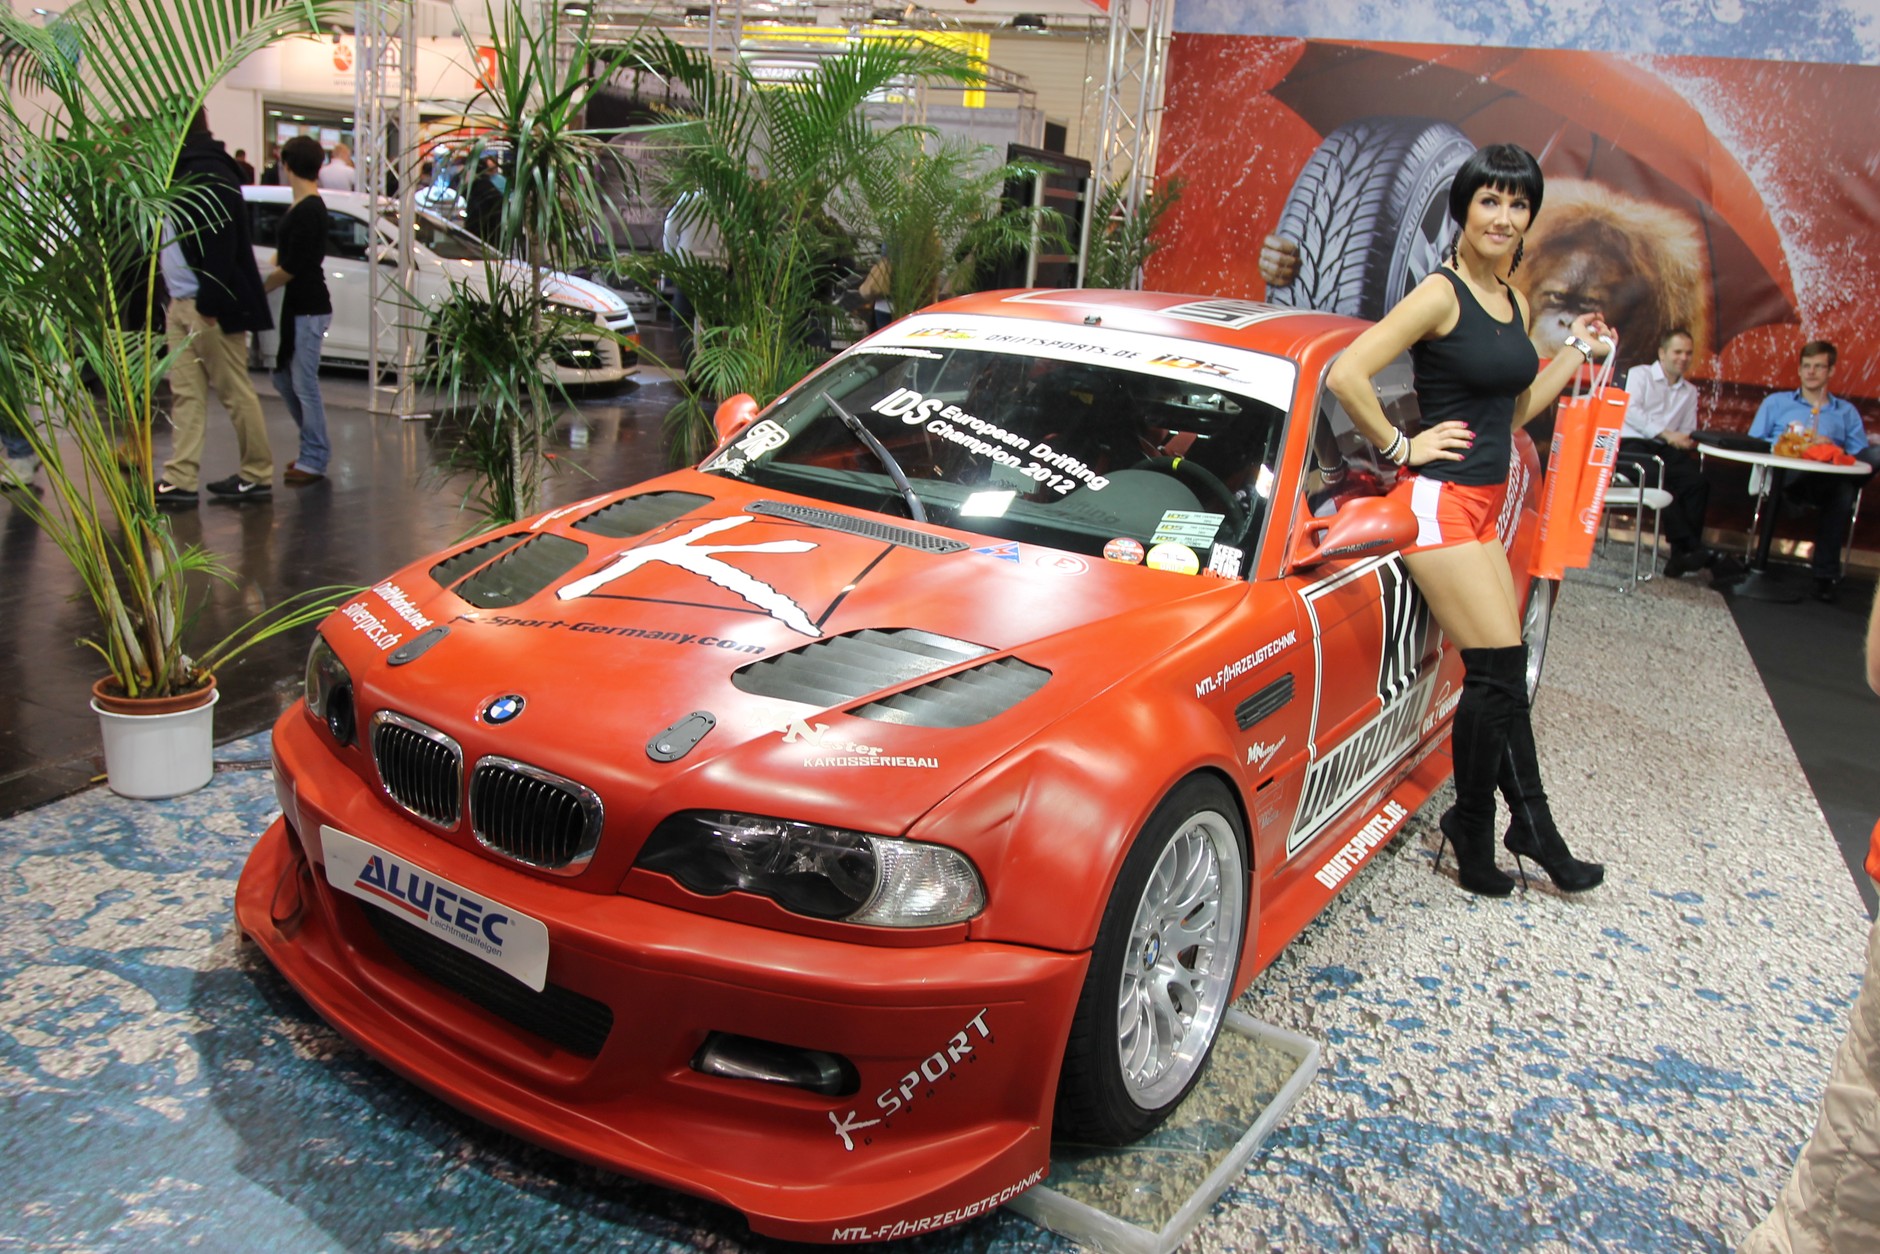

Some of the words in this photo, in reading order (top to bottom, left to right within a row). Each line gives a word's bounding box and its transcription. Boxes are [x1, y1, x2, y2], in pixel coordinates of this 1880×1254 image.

[1399, 162, 1441, 254] UNIROYAL
[871, 387, 944, 425] IDS
[939, 404, 1031, 451] European
[1029, 442, 1110, 492] Drifting
[926, 419, 1021, 469] Champion
[1020, 461, 1076, 495] 2012
[555, 514, 824, 639] K
[1195, 629, 1297, 699] MTL-FAHRZEUGTECHNIK
[803, 756, 939, 769] KAROSSERIEBAU
[1294, 681, 1428, 835] UNIROYAL
[1314, 799, 1408, 890] DRIFTSPORTS.DE
[358, 854, 509, 947] ALUTEC
[430, 916, 502, 957] Leichtmetallfelgen
[828, 1110, 881, 1151] K
[876, 1007, 991, 1117] SPORT
[832, 1167, 1044, 1241] MTL-FAHRZEUGTECHNIK
